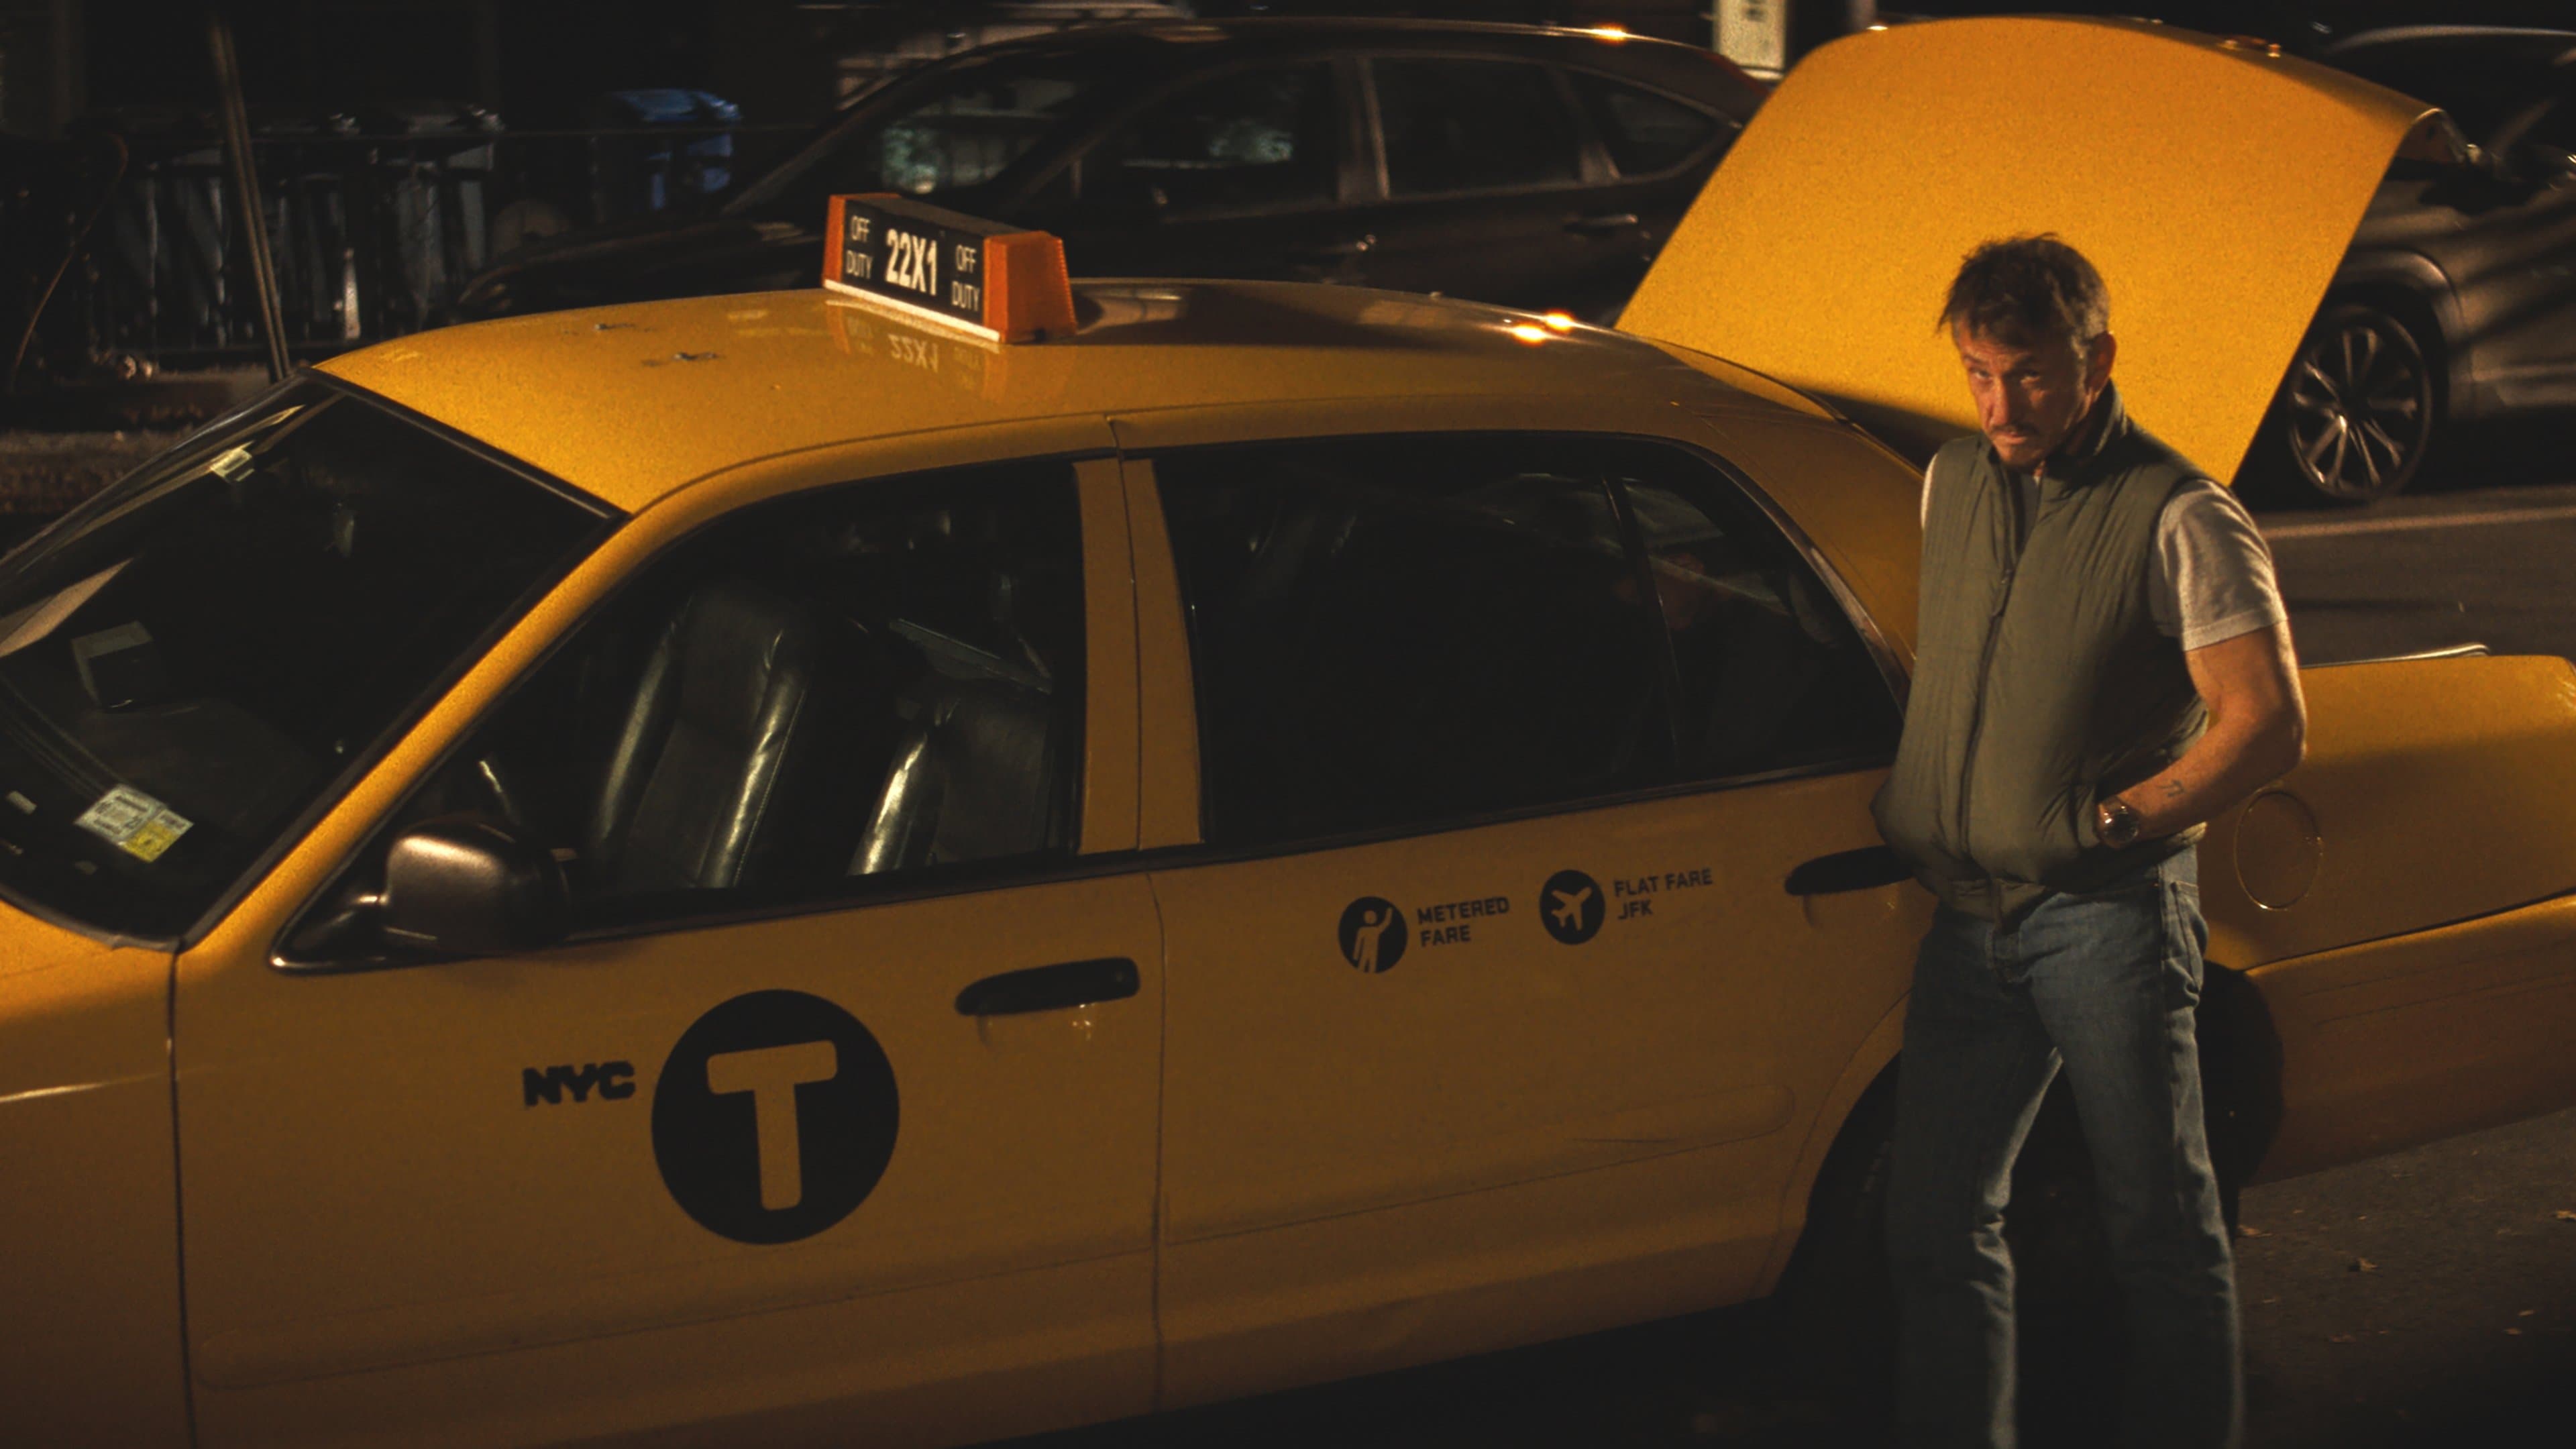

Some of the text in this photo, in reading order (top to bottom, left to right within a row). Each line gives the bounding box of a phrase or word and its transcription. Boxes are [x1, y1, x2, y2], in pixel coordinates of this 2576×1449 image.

[851, 215, 870, 241] OFF
[845, 250, 873, 280] DUTY
[885, 228, 938, 297] 22X1
[955, 244, 977, 272] OFF
[951, 281, 981, 312] DUTY
[1613, 868, 1713, 897] FLAT FARE
[1417, 896, 1510, 925] METERED
[1617, 899, 1653, 920] JFK
[1420, 924, 1471, 947] FARE
[522, 1039, 838, 1212] NYC T
